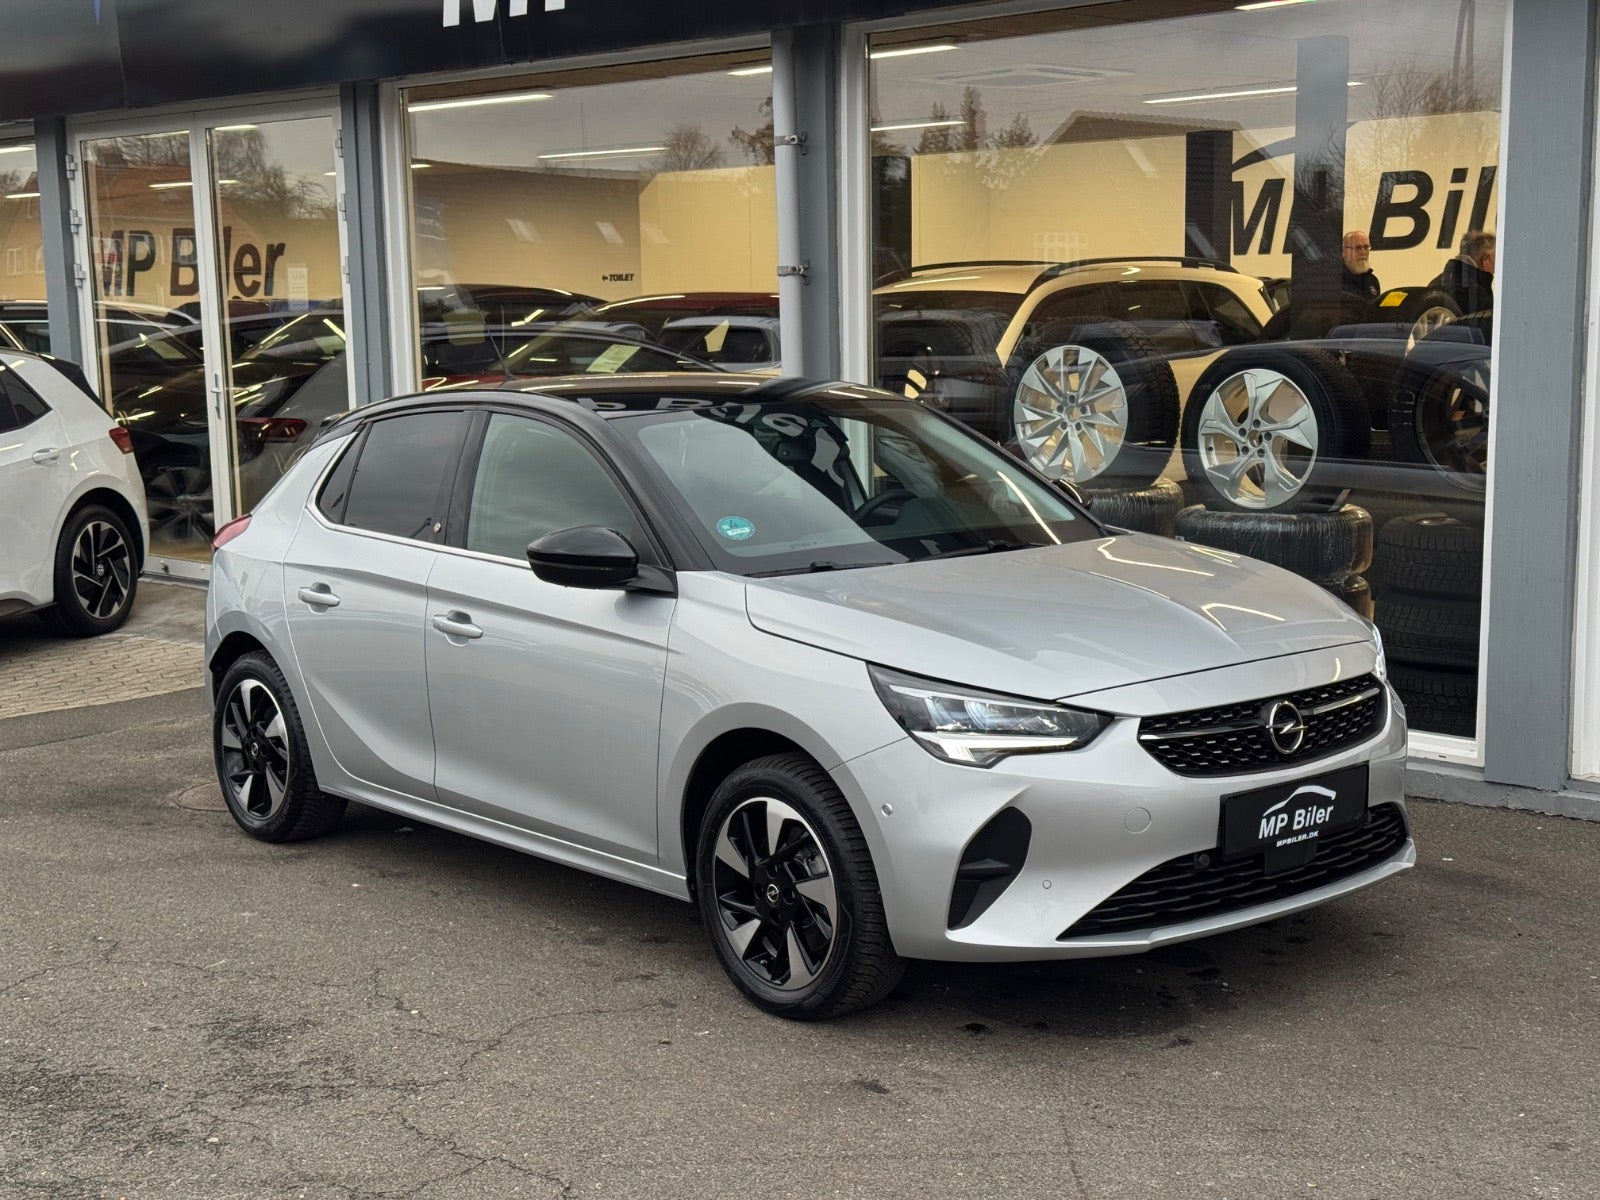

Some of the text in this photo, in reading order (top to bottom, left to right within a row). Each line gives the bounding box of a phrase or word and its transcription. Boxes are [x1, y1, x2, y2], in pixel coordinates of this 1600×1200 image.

[1231, 165, 1498, 256] M Bil
[170, 226, 286, 298] Bler
[609, 273, 635, 282] TOILET
[1258, 805, 1334, 839] MP Biler
[1276, 830, 1320, 848] MPBILER.DK
